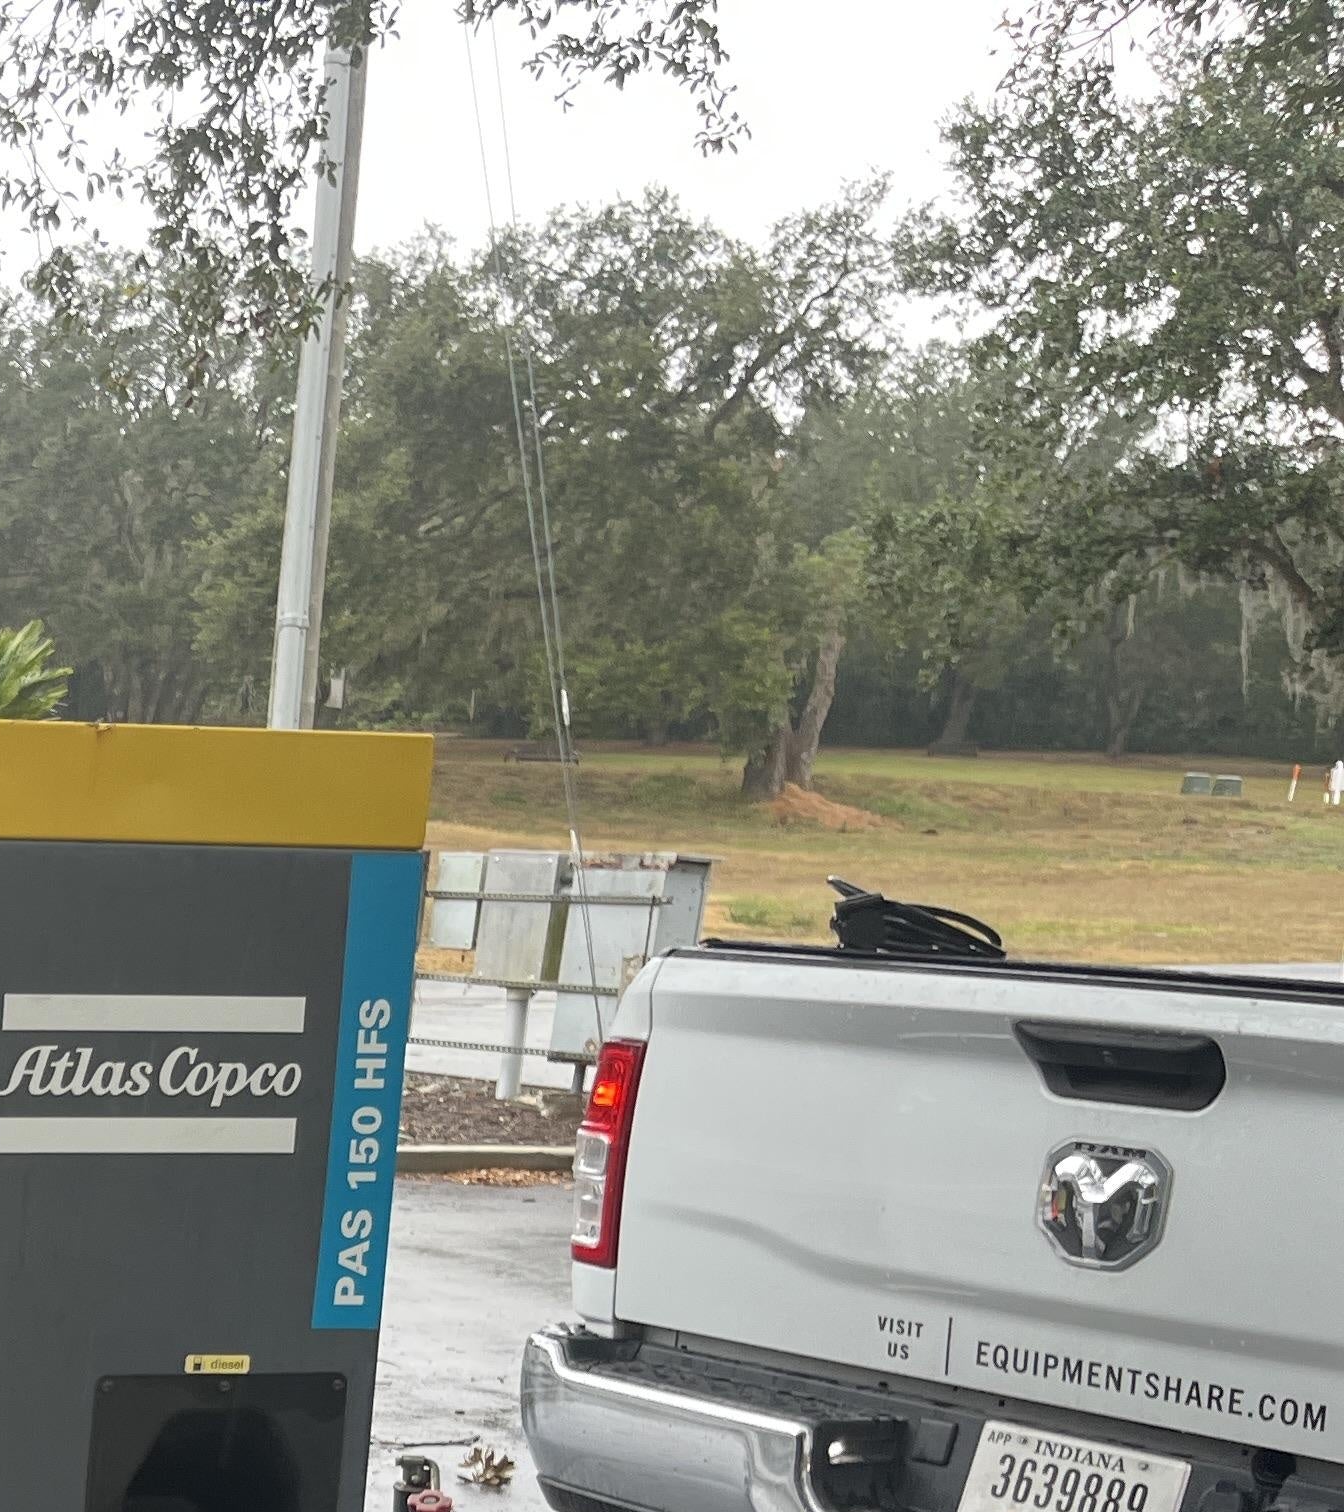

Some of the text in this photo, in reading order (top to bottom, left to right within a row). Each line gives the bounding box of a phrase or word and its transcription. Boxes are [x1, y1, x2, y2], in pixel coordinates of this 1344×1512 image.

[159, 1046, 302, 1107] Copco
[333, 998, 391, 1305] PAS 150 HFS
[877, 1315, 924, 1339] VISIT
[887, 1342, 910, 1360] US
[976, 1341, 1328, 1433] EQUIPMENTSHARE.COM
[987, 1431, 1126, 1473] APP INDIANA
